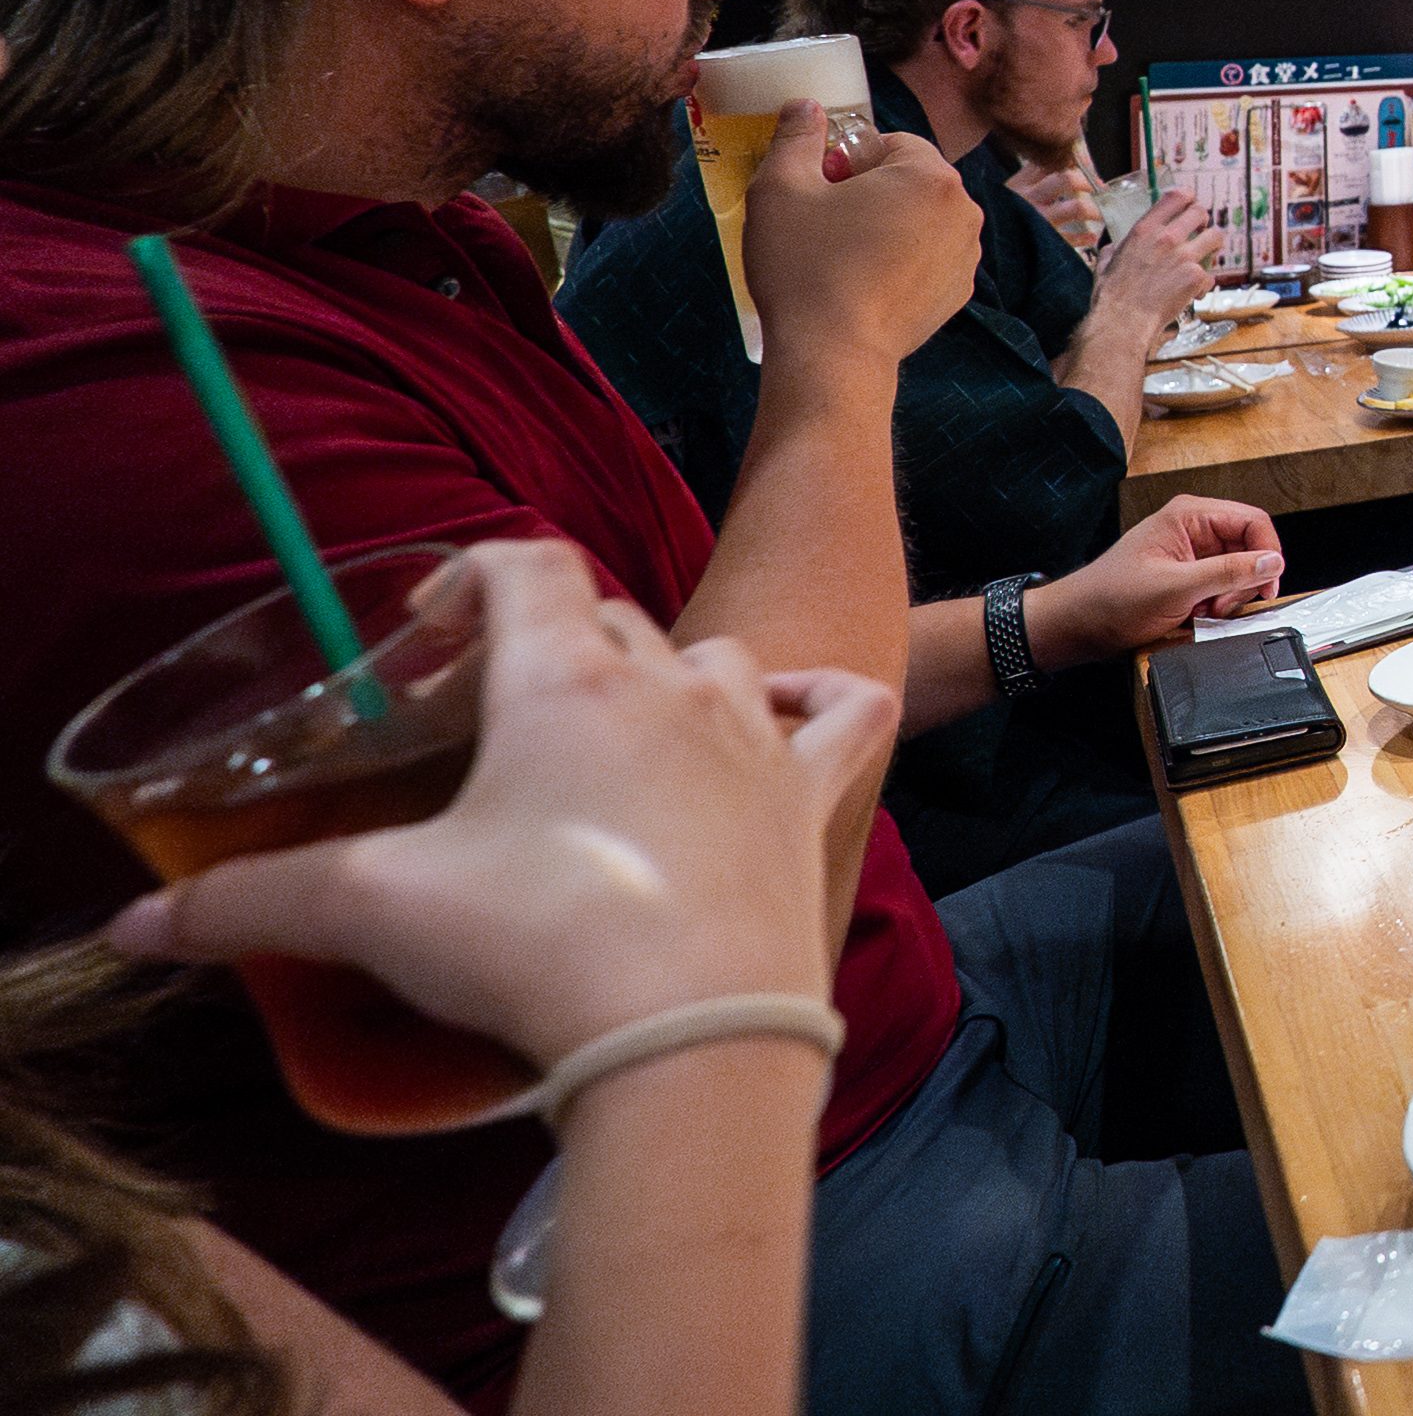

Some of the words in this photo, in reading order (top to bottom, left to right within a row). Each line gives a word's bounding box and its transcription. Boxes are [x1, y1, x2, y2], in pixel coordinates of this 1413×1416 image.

[1247, 61, 1382, 85] 食堂メニュー
